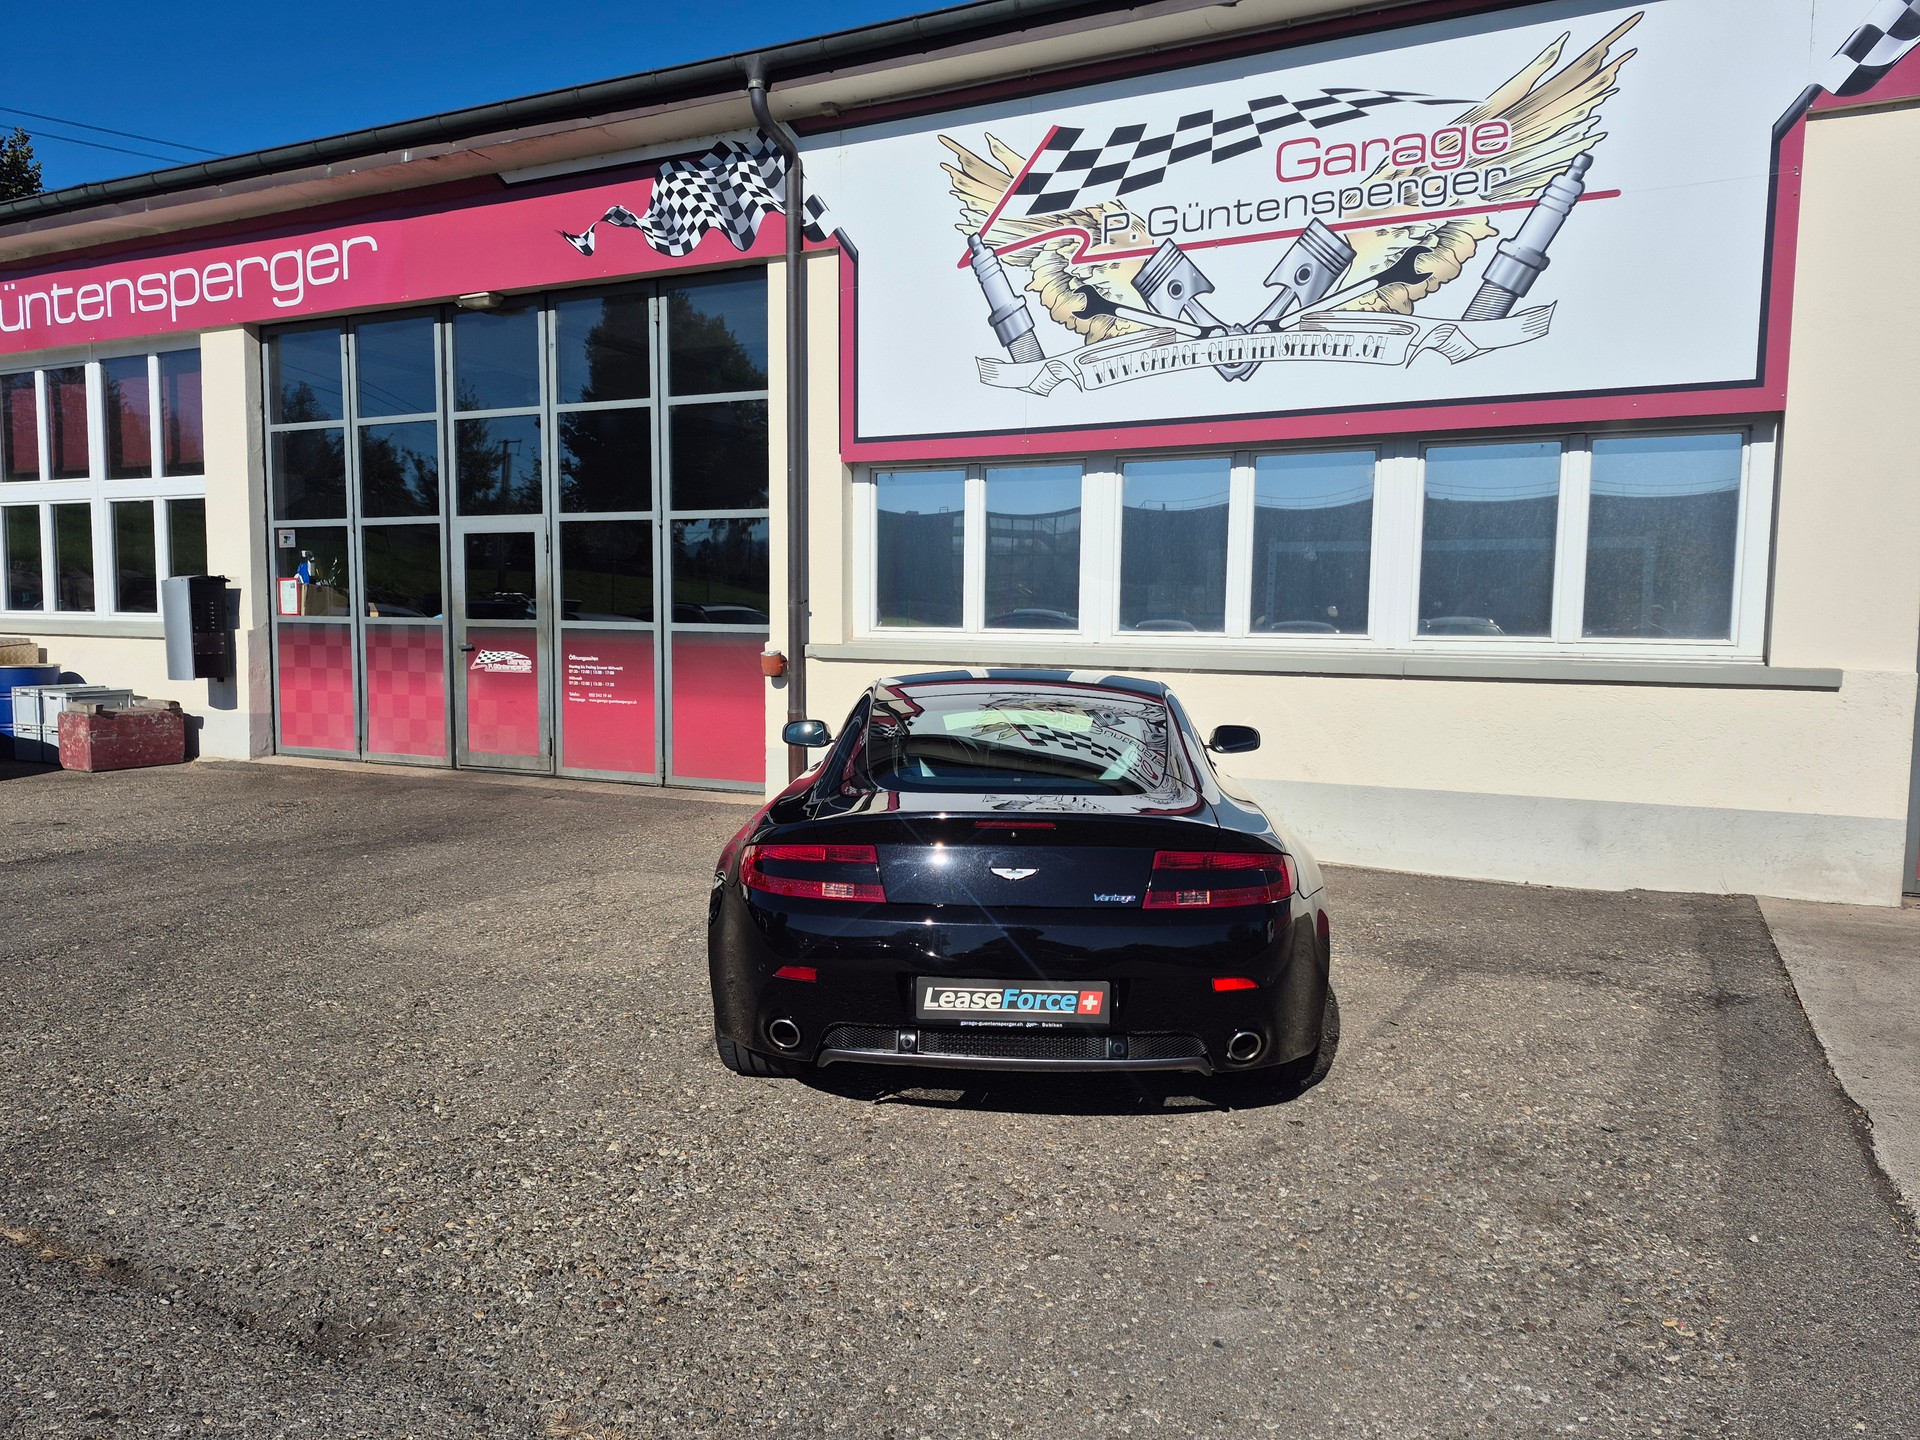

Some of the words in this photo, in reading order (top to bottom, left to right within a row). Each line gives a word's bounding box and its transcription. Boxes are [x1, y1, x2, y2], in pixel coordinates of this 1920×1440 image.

[1275, 121, 1512, 183] Garage
[1103, 213, 1137, 245] P.
[1147, 167, 1507, 238] Güntensperger
[1093, 893, 1136, 904] Vantage
[923, 986, 1077, 1011] LeaseForce
